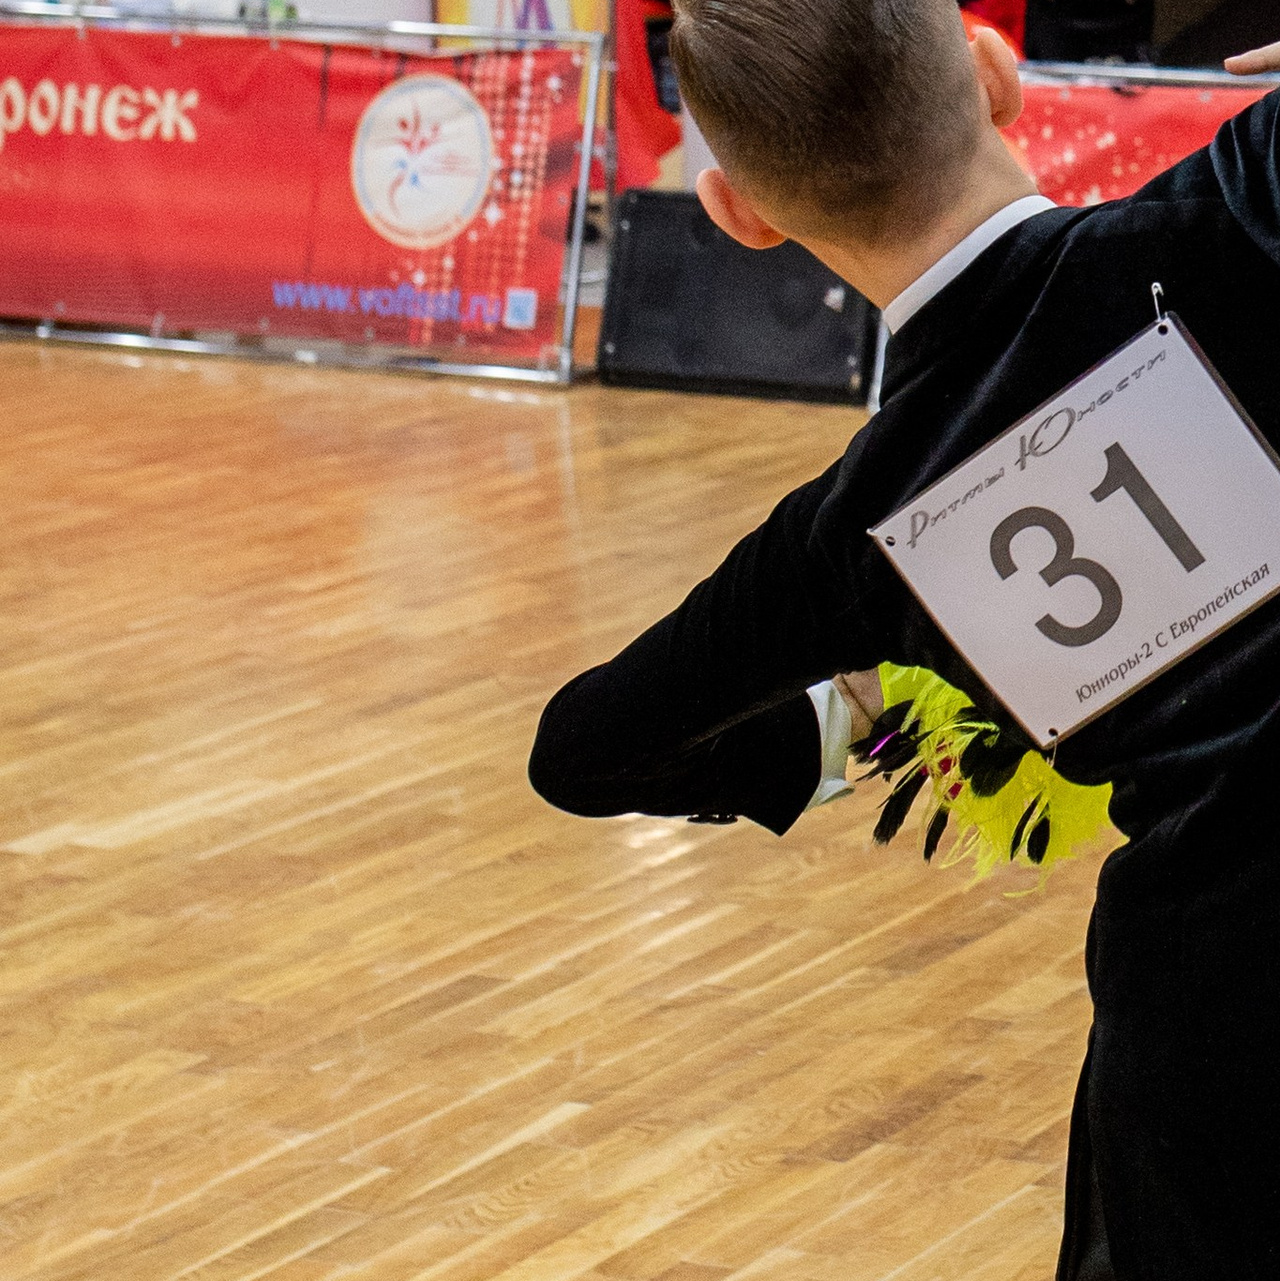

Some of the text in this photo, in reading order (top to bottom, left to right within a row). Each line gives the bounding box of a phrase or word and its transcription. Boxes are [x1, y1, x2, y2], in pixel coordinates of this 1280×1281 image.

[1014, 349, 1166, 471] Юности
[989, 441, 1207, 648] 31
[1075, 642, 1154, 703] Юниоры-2
[1169, 562, 1270, 640] Европейская
